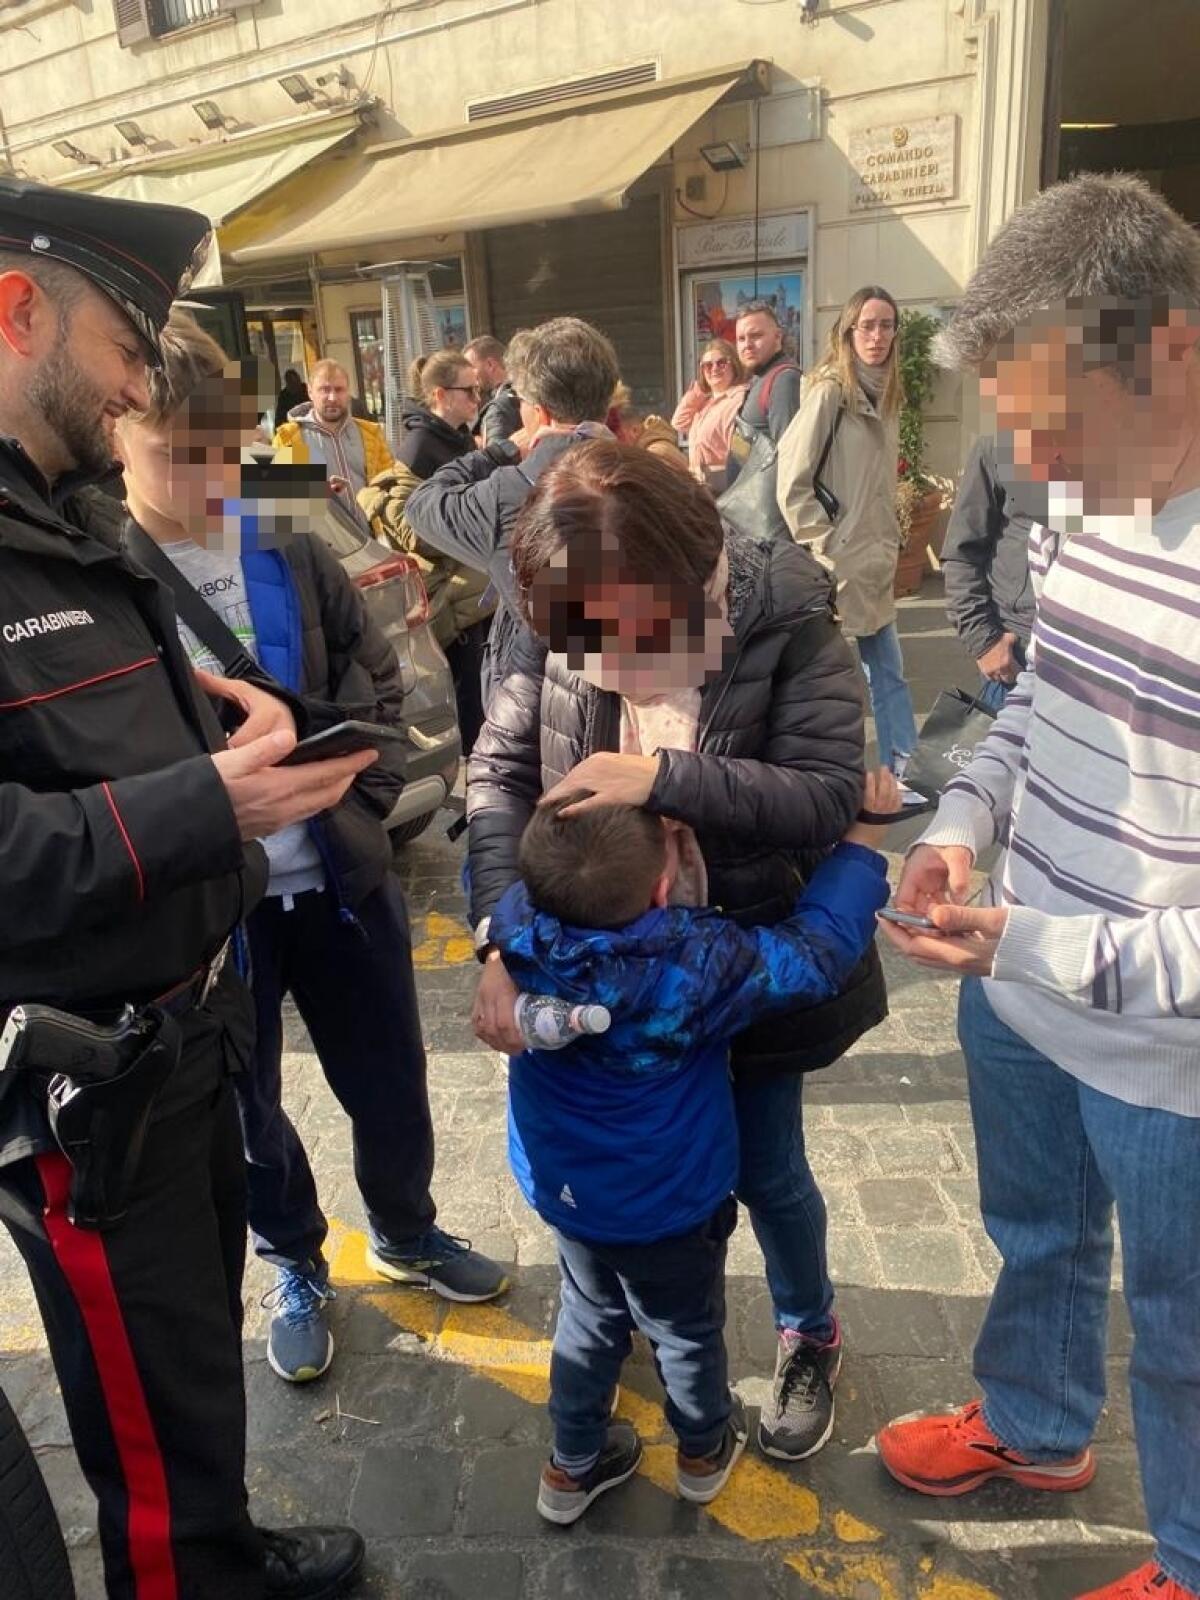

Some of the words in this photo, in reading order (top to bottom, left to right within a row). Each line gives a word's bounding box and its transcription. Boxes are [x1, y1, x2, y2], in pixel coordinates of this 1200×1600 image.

[866, 146, 934, 167] COMANDO
[861, 163, 939, 185] CARABINIERI
[901, 183, 946, 198] VENEZIA
